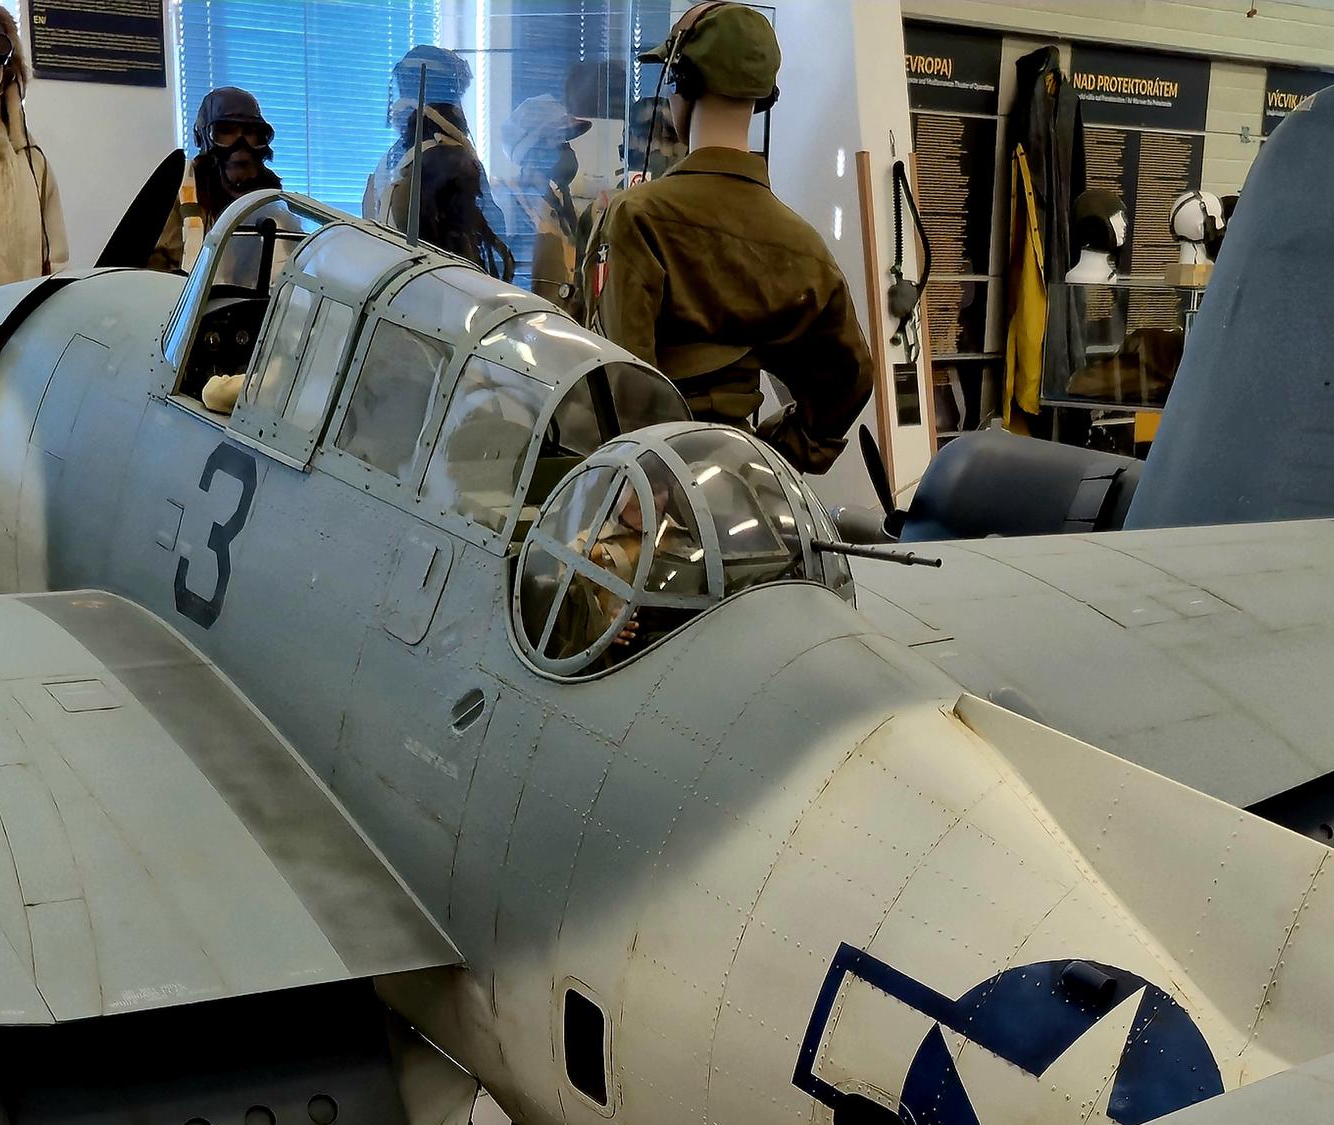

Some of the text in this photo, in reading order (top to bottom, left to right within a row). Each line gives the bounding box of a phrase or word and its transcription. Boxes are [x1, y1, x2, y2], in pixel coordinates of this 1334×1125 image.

[1073, 72, 1178, 98] NAD PROTEKTORÁTEM
[174, 440, 257, 630] 3
